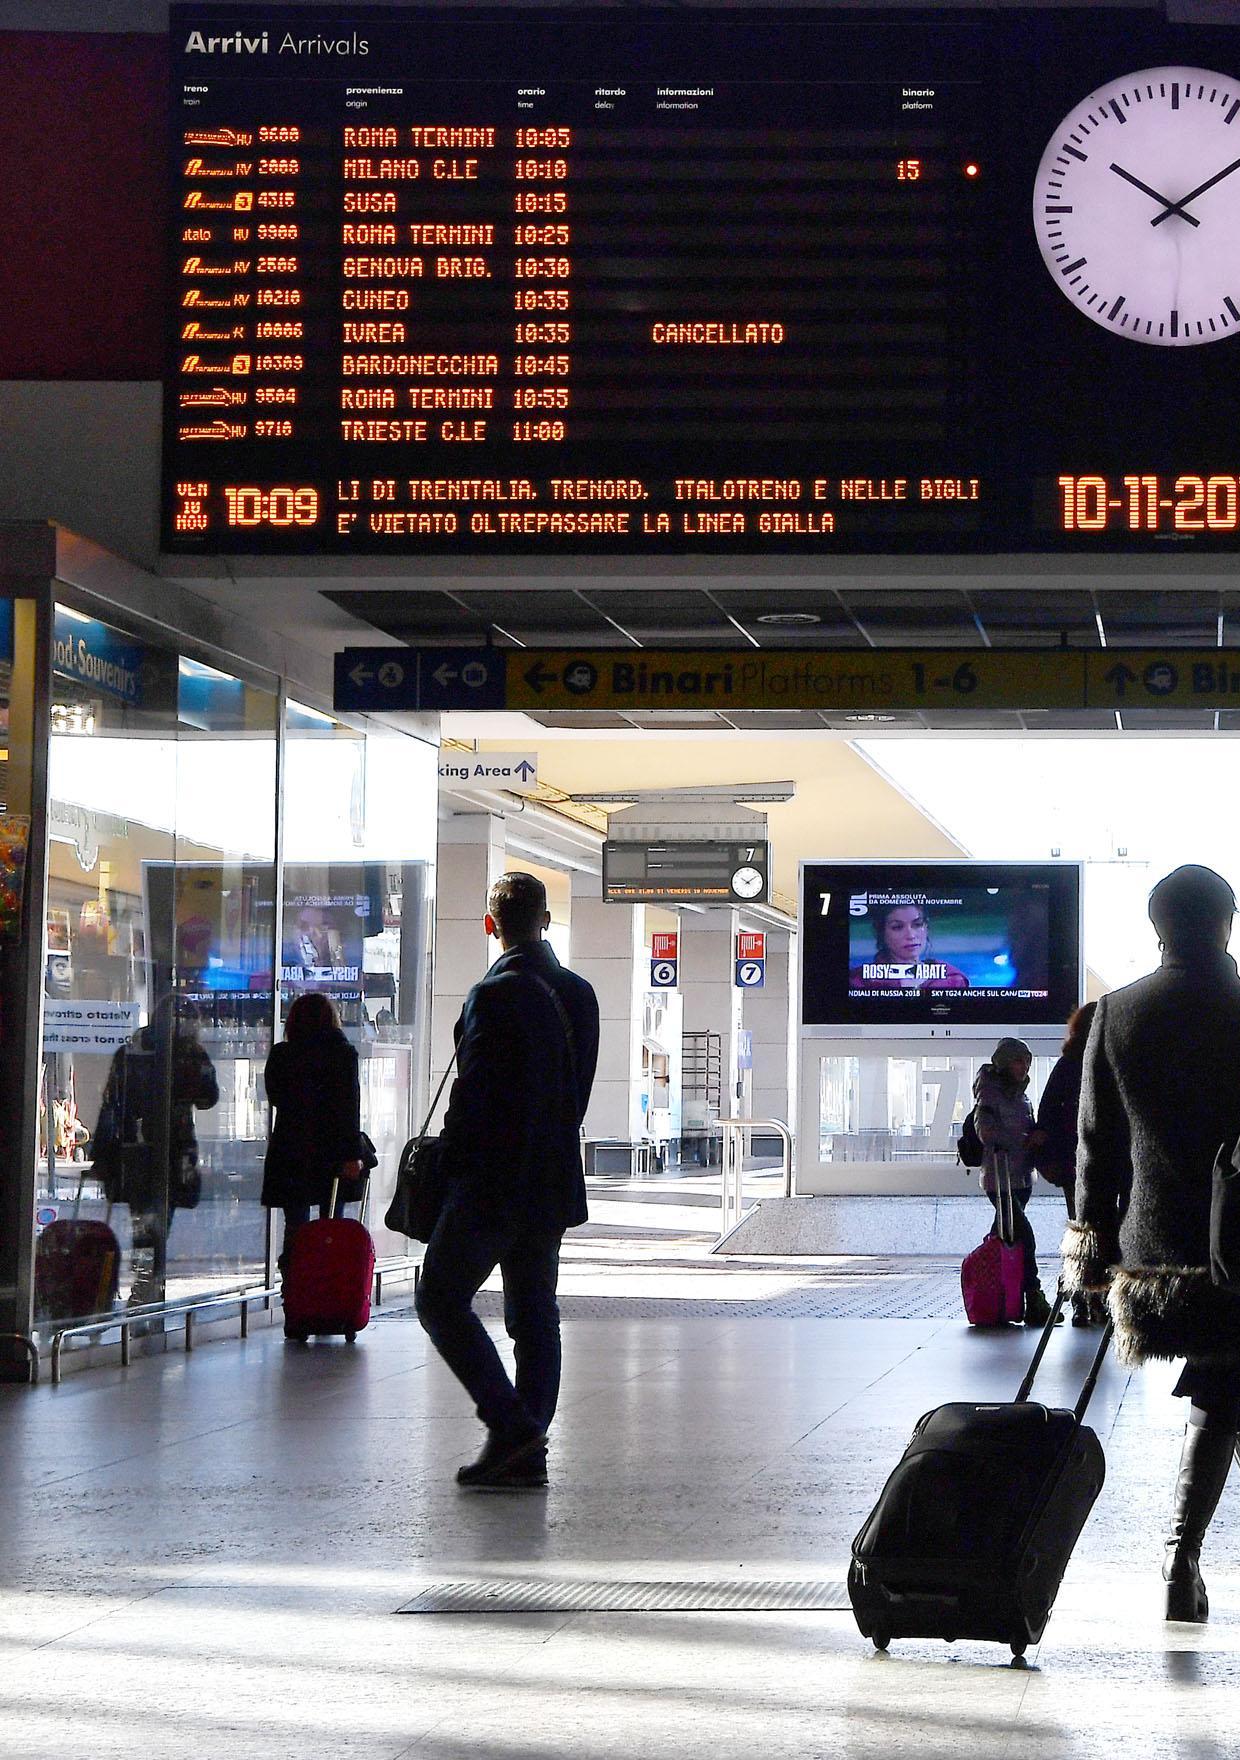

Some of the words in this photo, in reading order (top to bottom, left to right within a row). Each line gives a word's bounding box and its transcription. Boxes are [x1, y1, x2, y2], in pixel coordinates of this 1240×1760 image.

[186, 32, 268, 53] Arrivi
[279, 32, 368, 54] Arrivals
[183, 85, 209, 93] treno
[346, 86, 403, 96] provenienza
[517, 87, 546, 96] orario
[594, 87, 626, 96] ritardo
[657, 87, 714, 96] informazioni
[902, 88, 935, 97] binario
[183, 98, 201, 106] train
[345, 100, 368, 109] origin
[517, 101, 534, 109] time
[594, 100, 614, 109] delay
[656, 100, 699, 110] information
[901, 100, 933, 110] platform
[344, 128, 398, 147] ROMA
[411, 126, 495, 147] TERMINI
[516, 128, 571, 147] 10:05
[344, 158, 420, 179] MILANO
[433, 159, 477, 179] C.LE
[515, 160, 568, 179] 10:10
[897, 160, 921, 180] 15
[344, 192, 398, 212] SUSA
[515, 192, 568, 212] 10:15
[343, 224, 397, 244] ROMA
[410, 224, 494, 244] TERMINI
[515, 224, 570, 245] 10:25
[344, 256, 424, 277] GENOVA
[435, 256, 491, 277] BRIG.
[515, 257, 571, 277] 10:30
[343, 289, 409, 310] CUNEO
[515, 290, 569, 310] 10:35
[344, 322, 407, 343] IVREA
[515, 322, 569, 343] 10:35
[653, 322, 784, 343] CANCELLATO
[343, 354, 498, 375] BARDONECCHIA
[514, 354, 569, 375] 10:45
[341, 420, 427, 441] TRIESTE
[442, 421, 486, 441] C.LE
[513, 421, 566, 441] 11:00
[223, 485, 320, 527] 10:09
[338, 514, 357, 533] E'
[370, 512, 456, 533] VIETATO
[471, 512, 629, 533] OLTREPASSARE
[644, 513, 671, 532] LA
[684, 513, 744, 533] LINEA
[759, 512, 835, 533] GIALLA
[612, 662, 733, 695] Binari
[741, 662, 893, 695] Platforms
[911, 662, 980, 695] 1-6
[474, 764, 511, 777] Area
[746, 848, 755, 863] 7
[820, 893, 830, 915] 7
[659, 967, 669, 980] 6
[746, 967, 756, 980] 7
[863, 964, 890, 979] ROSY
[916, 964, 947, 979] ABATE
